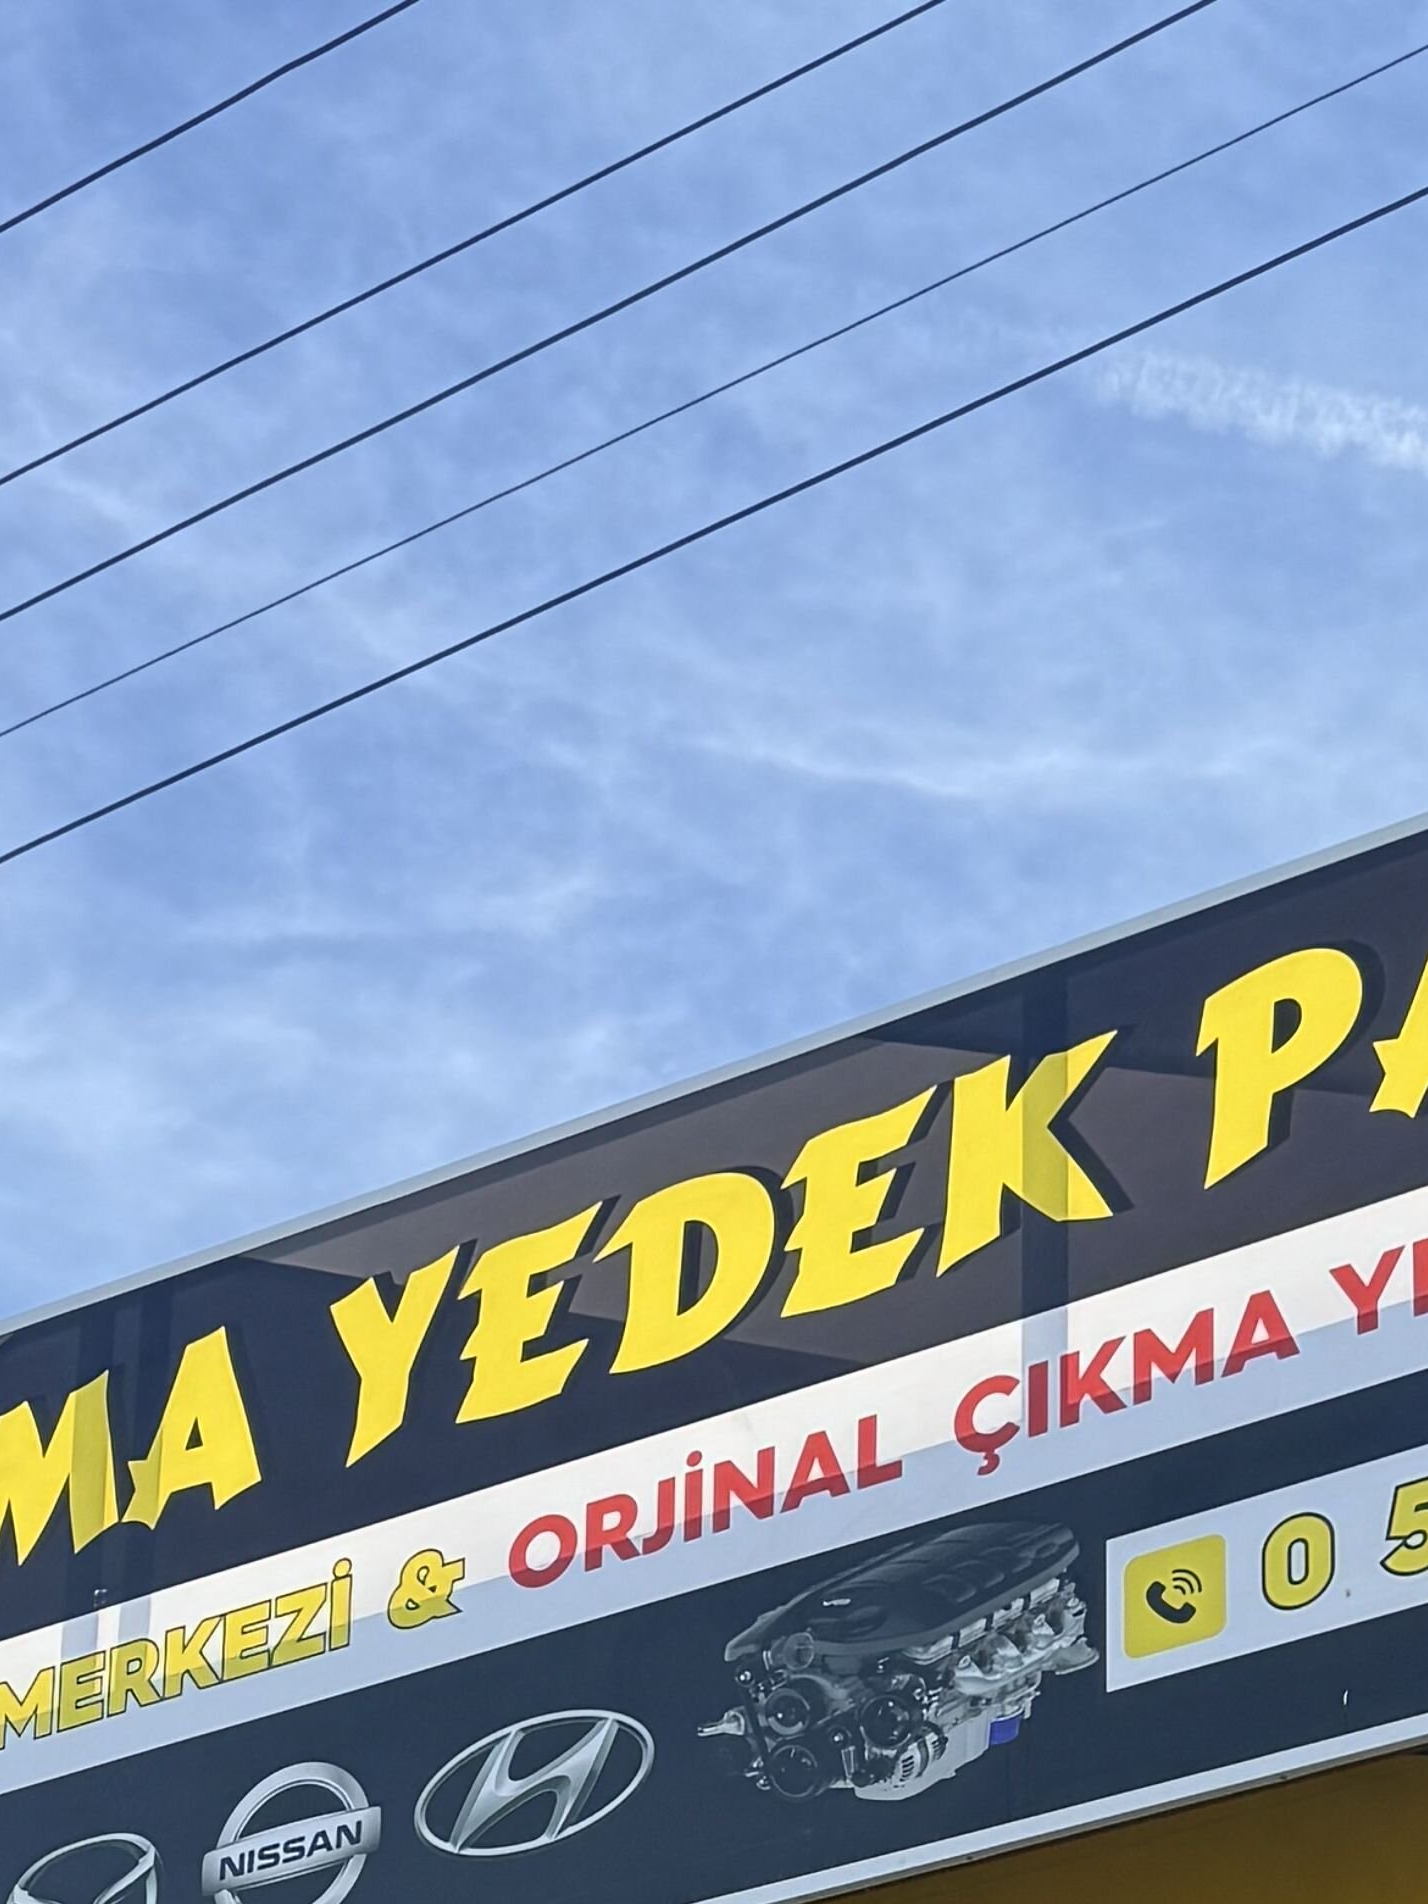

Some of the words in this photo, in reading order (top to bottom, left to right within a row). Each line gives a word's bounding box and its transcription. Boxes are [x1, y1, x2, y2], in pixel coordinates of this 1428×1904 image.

[330, 1034, 1111, 1462] YEDEK
[386, 1548, 465, 1629] &
[508, 1416, 902, 1589] ORJİNAL
[953, 1290, 1296, 1474] ÇIKMA
[1260, 1512, 1334, 1610] 0
[217, 1816, 364, 1881] NISSAN
